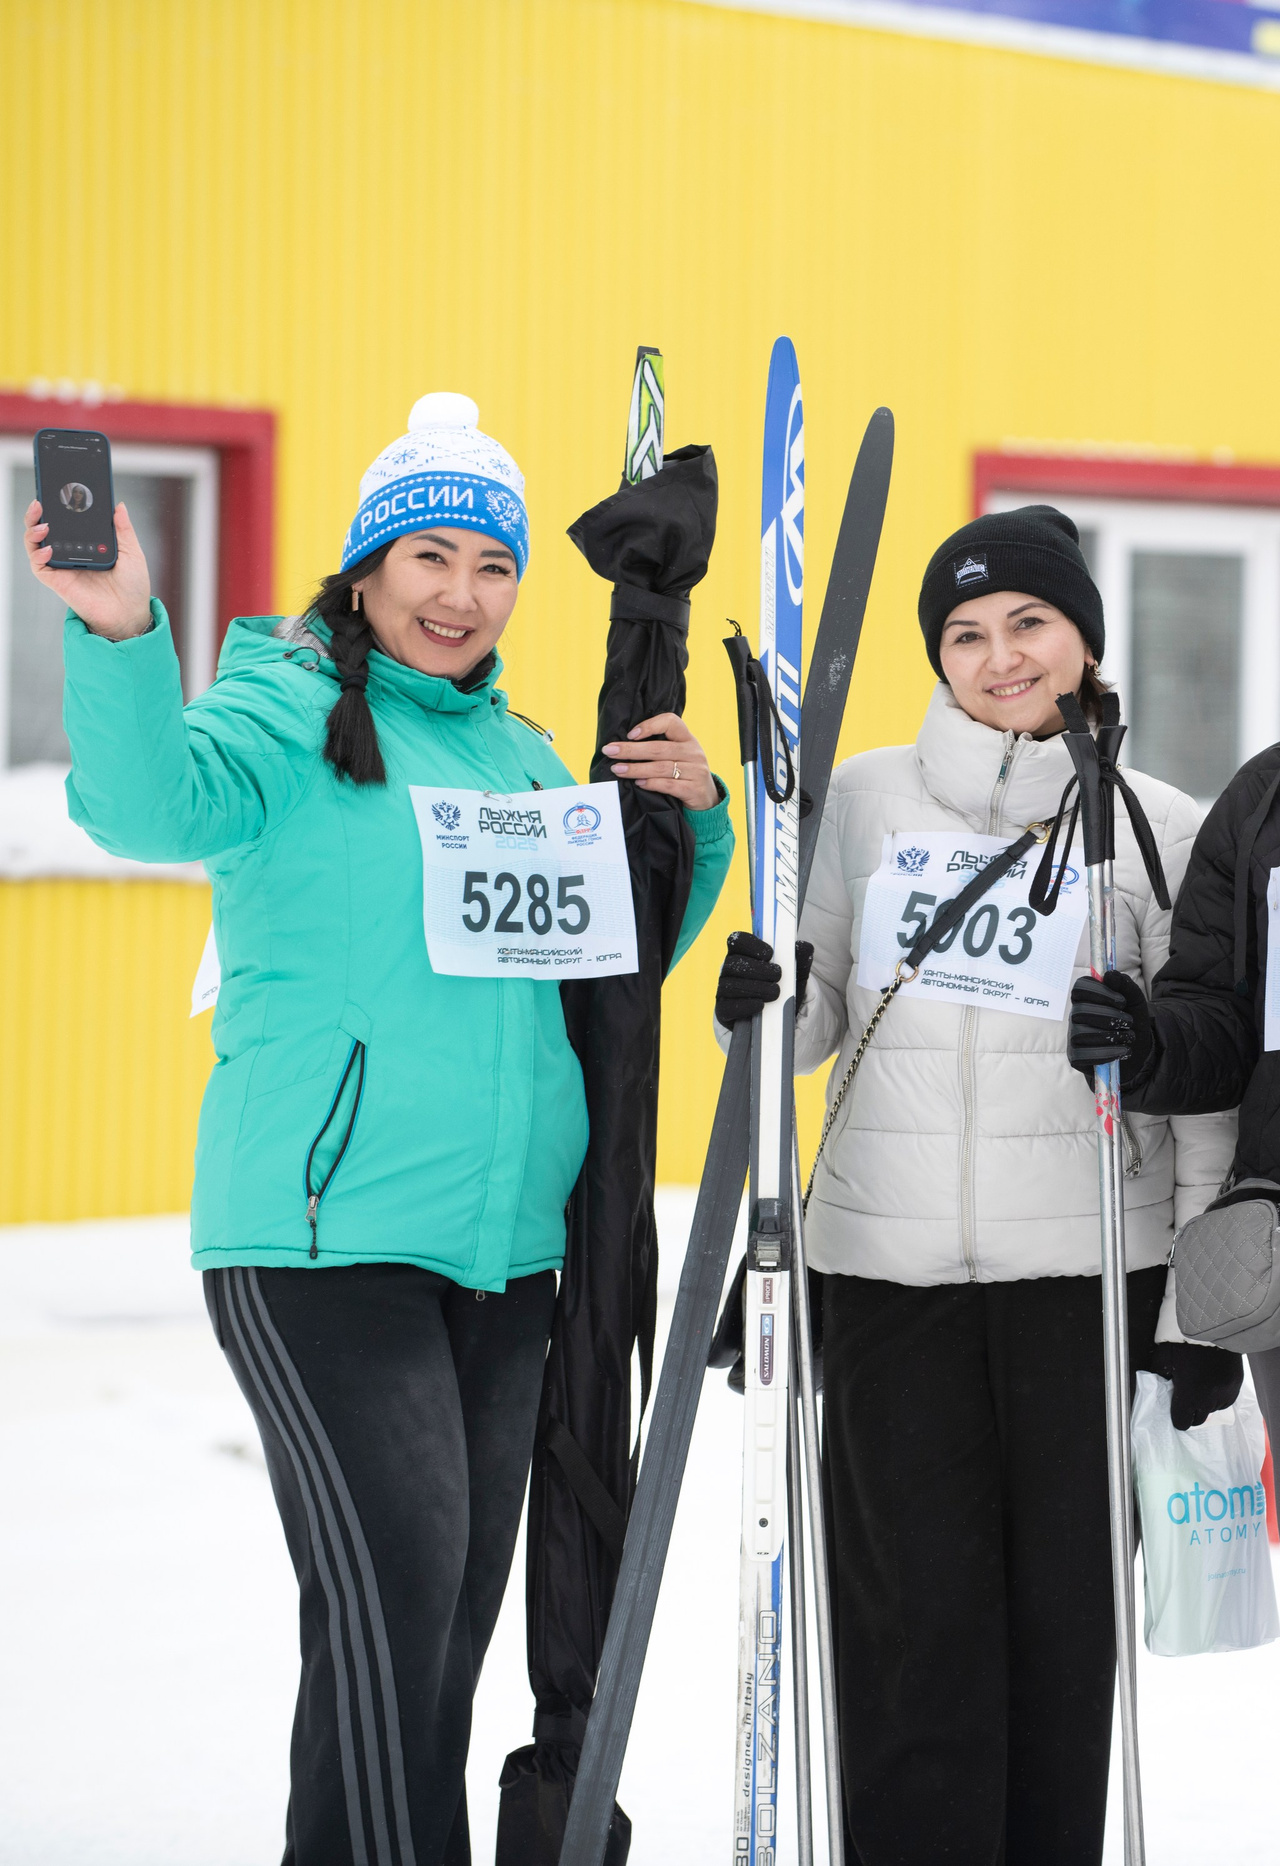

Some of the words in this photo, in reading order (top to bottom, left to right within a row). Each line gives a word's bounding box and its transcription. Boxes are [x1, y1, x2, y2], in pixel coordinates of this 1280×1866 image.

[360, 485, 474, 535] РОССИИ
[479, 807, 542, 824] ЛЫЖНЯ
[436, 834, 470, 842] МИНСПОРТ
[478, 820, 547, 838] РОССИИ
[495, 834, 539, 851] 2025
[462, 871, 590, 935] 5285
[896, 890, 1037, 965] 5003
[554, 957, 582, 965] ОКРУГ
[596, 953, 622, 962] ЮГРА
[923, 969, 1014, 991] ХАНТЫ-МАНСИЙСКИЙ
[921, 978, 979, 994] АВТОНОМНЫЙ
[983, 987, 1011, 999] ОКРУГ
[1024, 996, 1050, 1008] ЮГРА
[1190, 1521, 1262, 1546] ATOMY
[744, 1672, 753, 1707] Italy
[743, 1712, 752, 1726] in
[757, 1610, 777, 1866] BOLZANO
[742, 1731, 752, 1798] designed
